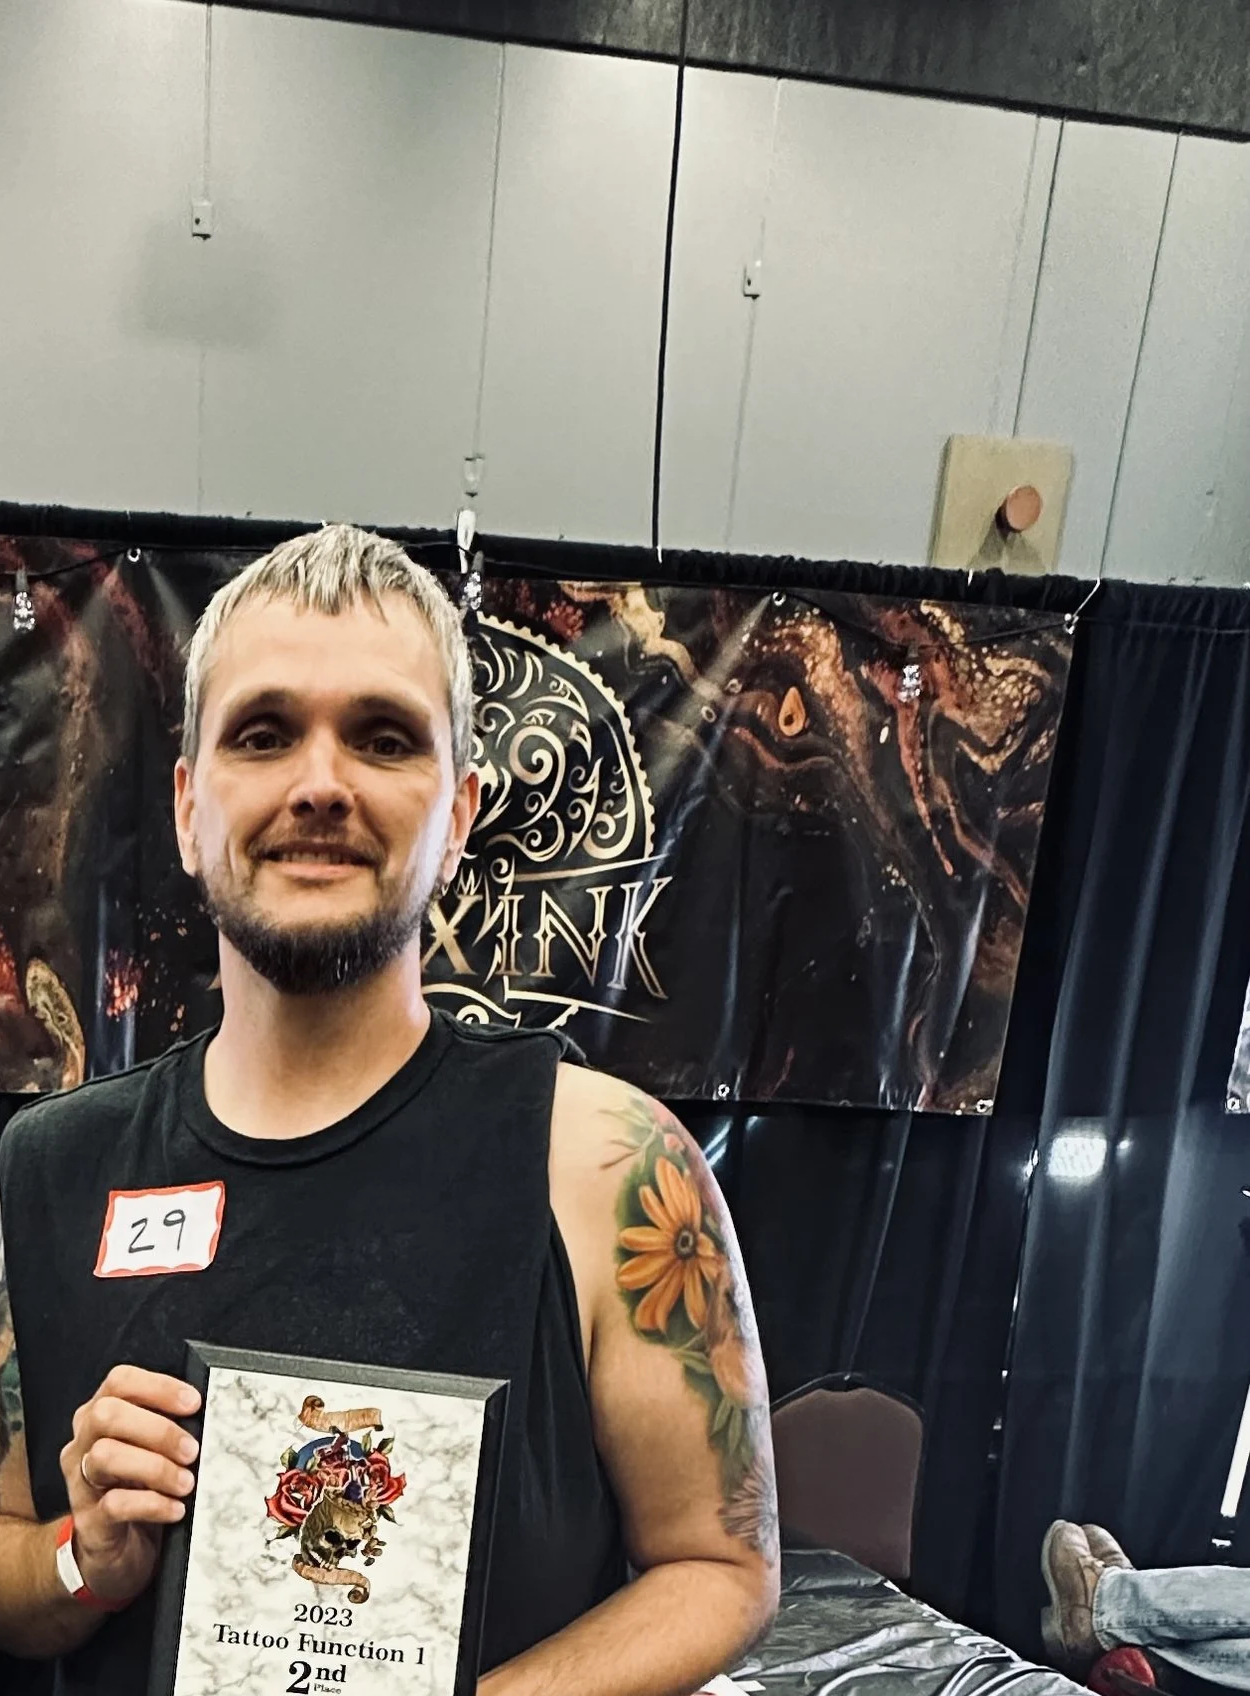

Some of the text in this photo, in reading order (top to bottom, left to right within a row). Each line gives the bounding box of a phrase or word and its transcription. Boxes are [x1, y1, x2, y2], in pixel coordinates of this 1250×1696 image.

[128, 1209, 186, 1254] 29
[294, 1603, 353, 1628] 2023
[213, 1623, 426, 1665] Tattoo Function 1
[285, 1660, 347, 1695] 2nd
[314, 1682, 342, 1694] Place
